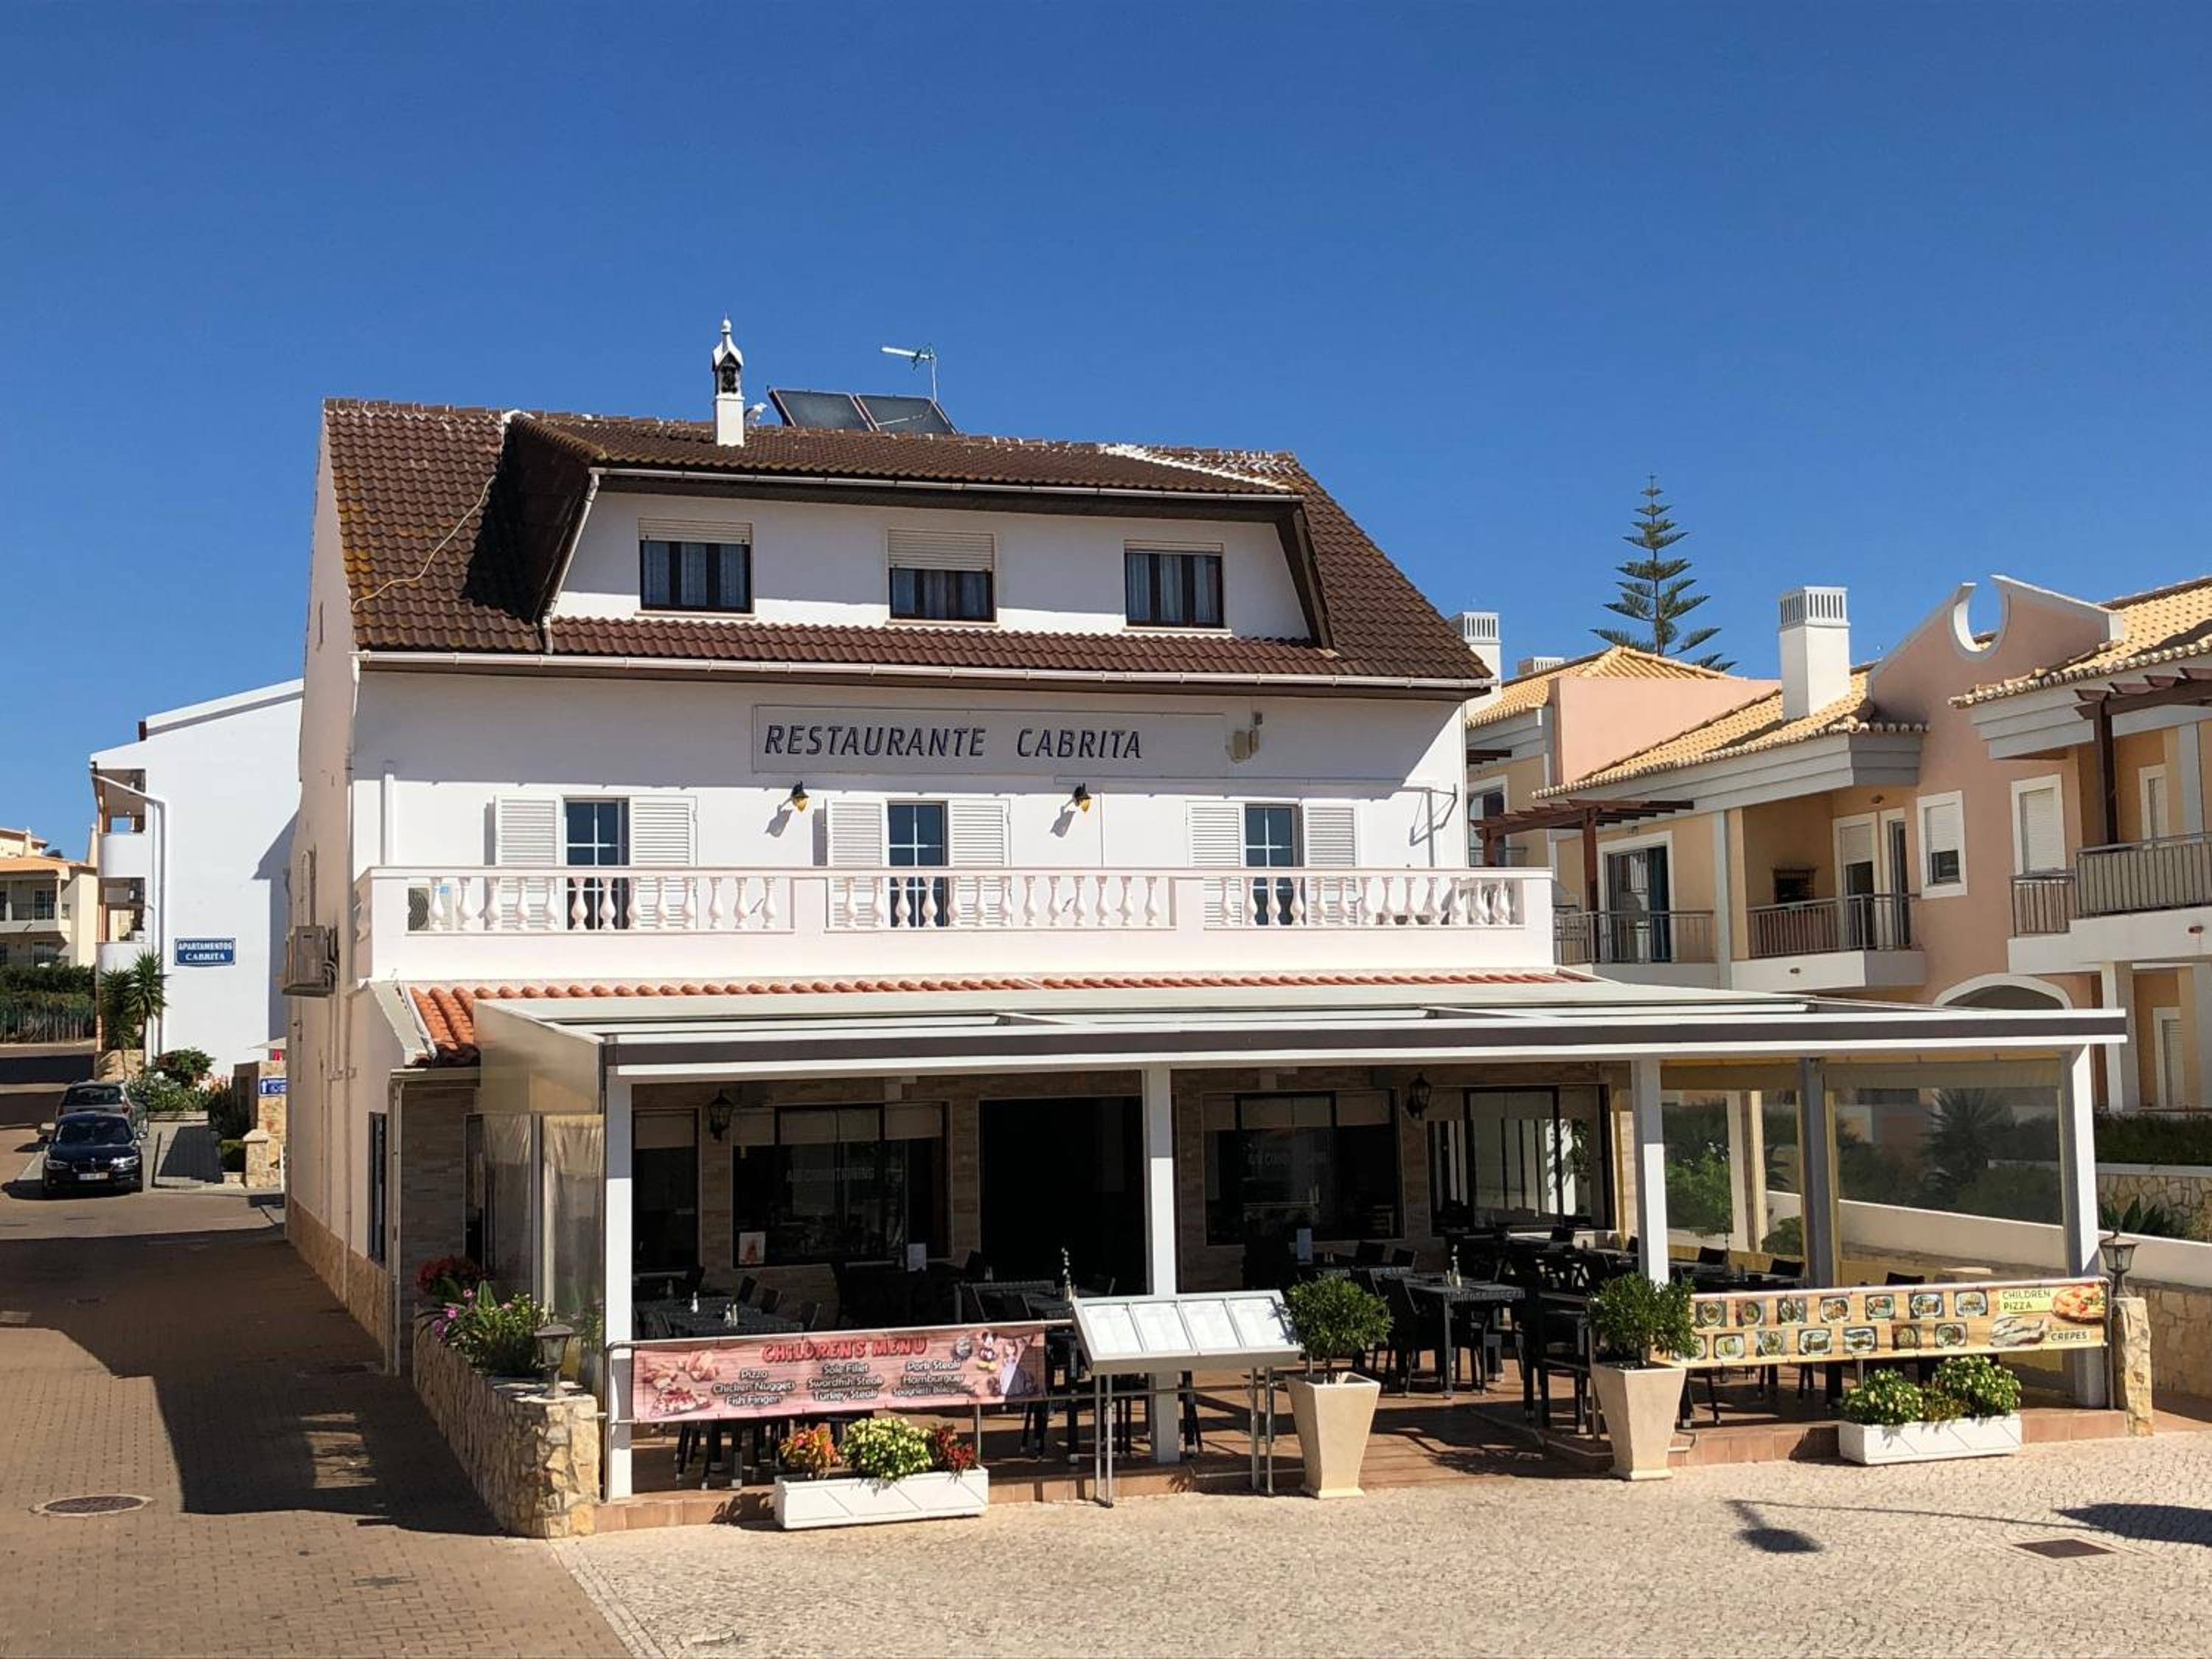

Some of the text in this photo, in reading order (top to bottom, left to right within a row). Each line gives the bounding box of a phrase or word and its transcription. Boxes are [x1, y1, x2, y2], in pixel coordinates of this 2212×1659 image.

[765, 725, 1142, 759] RESTAURANTE CABRITA
[178, 942, 232, 950] APARTAMENTOS
[185, 953, 225, 961] CABRITA
[2002, 1290, 2051, 1299] CHILDREN
[2003, 1301, 2033, 1310] PIZZA
[872, 1338, 927, 1357] MENU
[907, 1358, 961, 1371] Pork Steak
[740, 1369, 768, 1379] Pizza
[712, 1380, 796, 1394] Chicken Nuggets
[808, 1375, 884, 1389] Swordfish Steak
[726, 1395, 745, 1405] Fish
[814, 1388, 878, 1402] Turkey Steak
